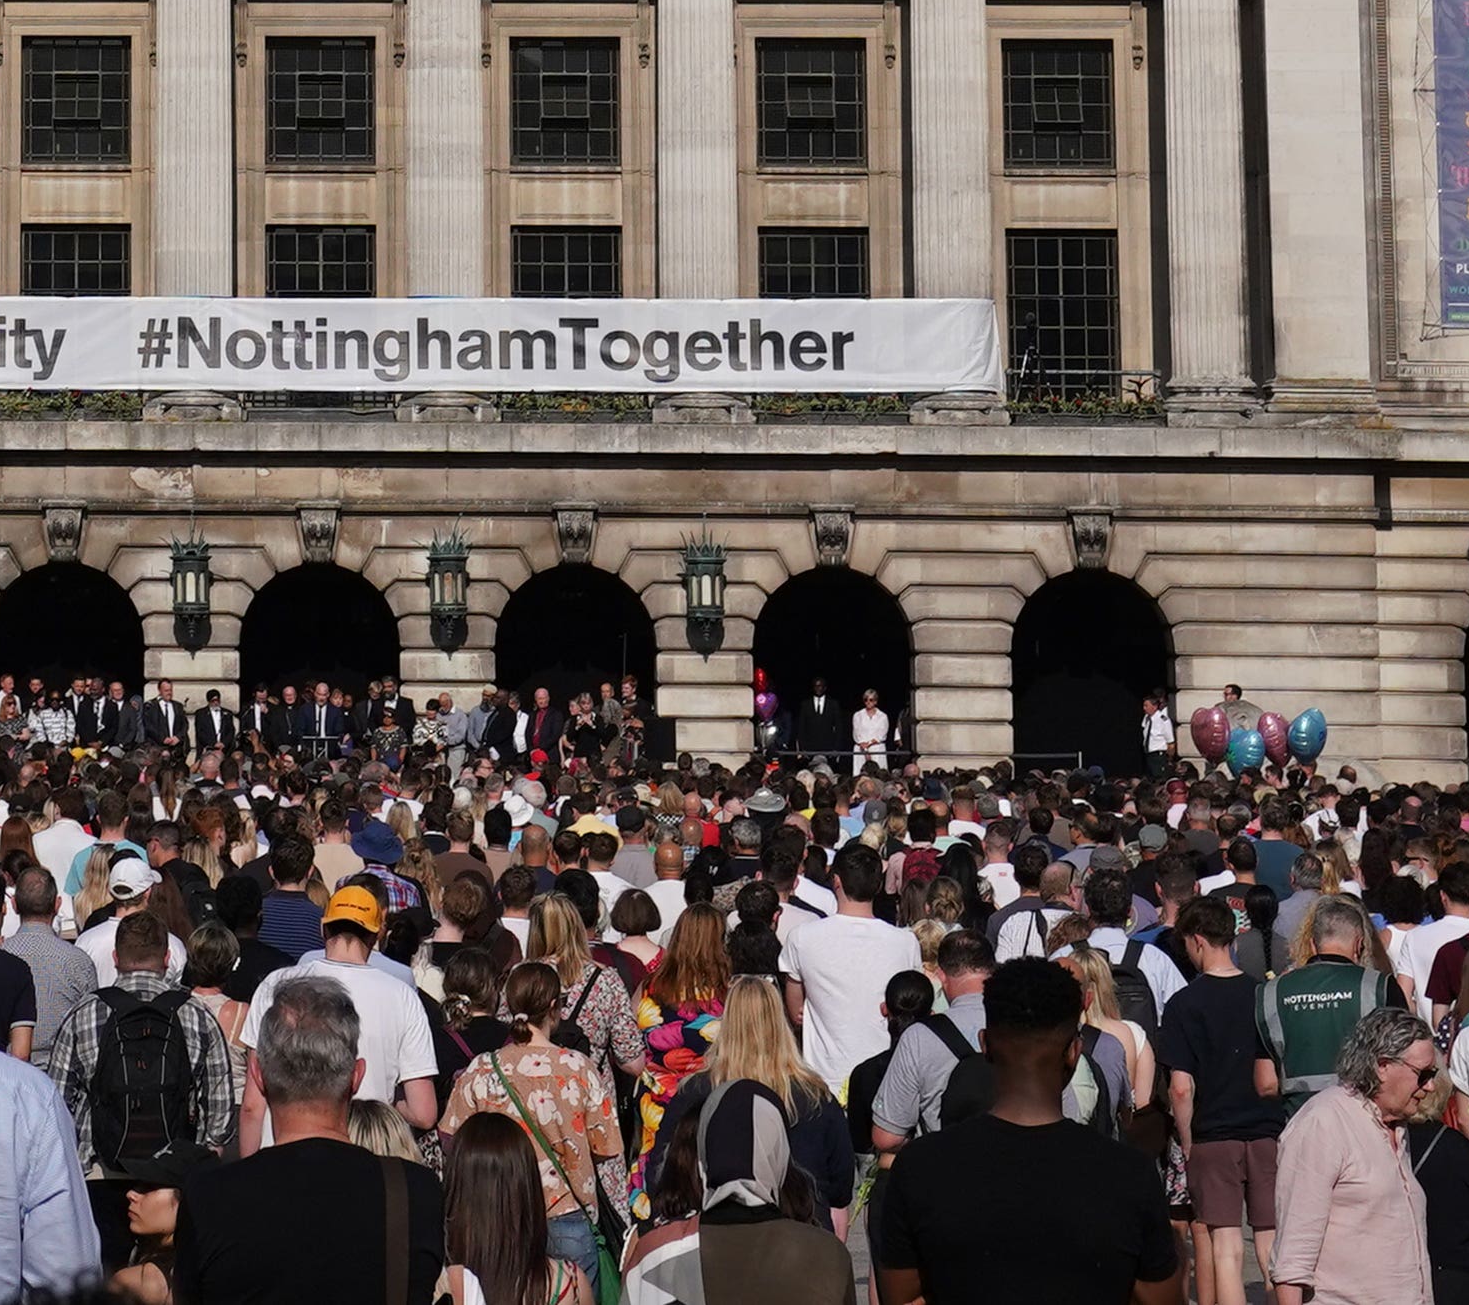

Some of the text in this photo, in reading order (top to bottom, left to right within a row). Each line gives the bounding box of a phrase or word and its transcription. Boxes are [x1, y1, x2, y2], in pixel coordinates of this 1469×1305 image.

[137, 316, 855, 384] #NottinghamTogether
[1284, 992, 1352, 1005] NOTTINGHAM
[1294, 1001, 1339, 1011] EVENTS
